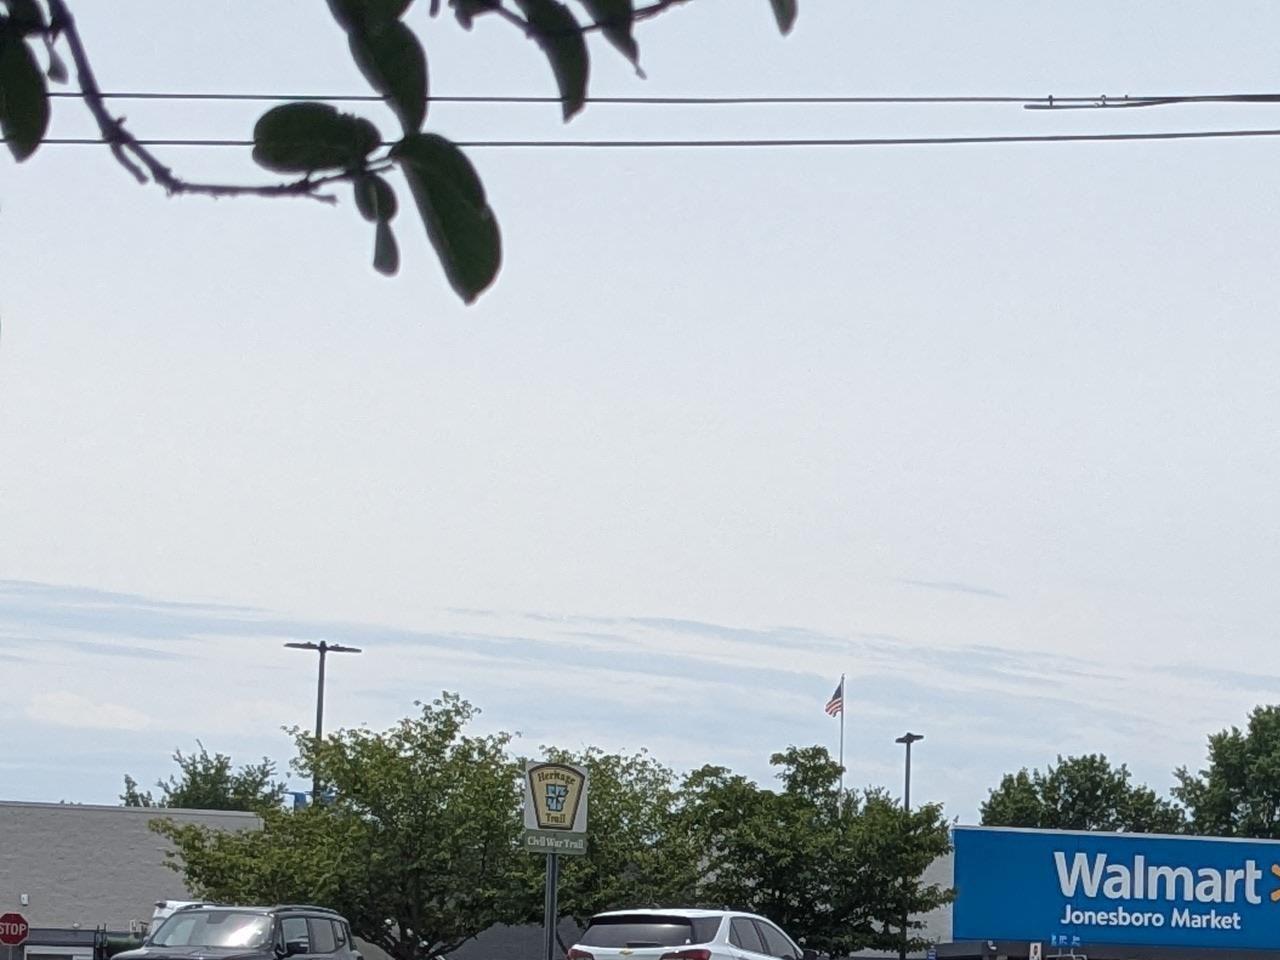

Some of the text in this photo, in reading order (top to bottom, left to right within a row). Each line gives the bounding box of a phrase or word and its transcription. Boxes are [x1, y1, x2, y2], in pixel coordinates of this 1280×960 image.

[537, 770, 576, 785] Heritage
[545, 812, 566, 824] Trail
[527, 835, 584, 849] Civil War Trail
[1053, 851, 1263, 905] Walmart
[1060, 904, 1242, 930] Jonesboro Market
[0, 922, 27, 936] STOP
